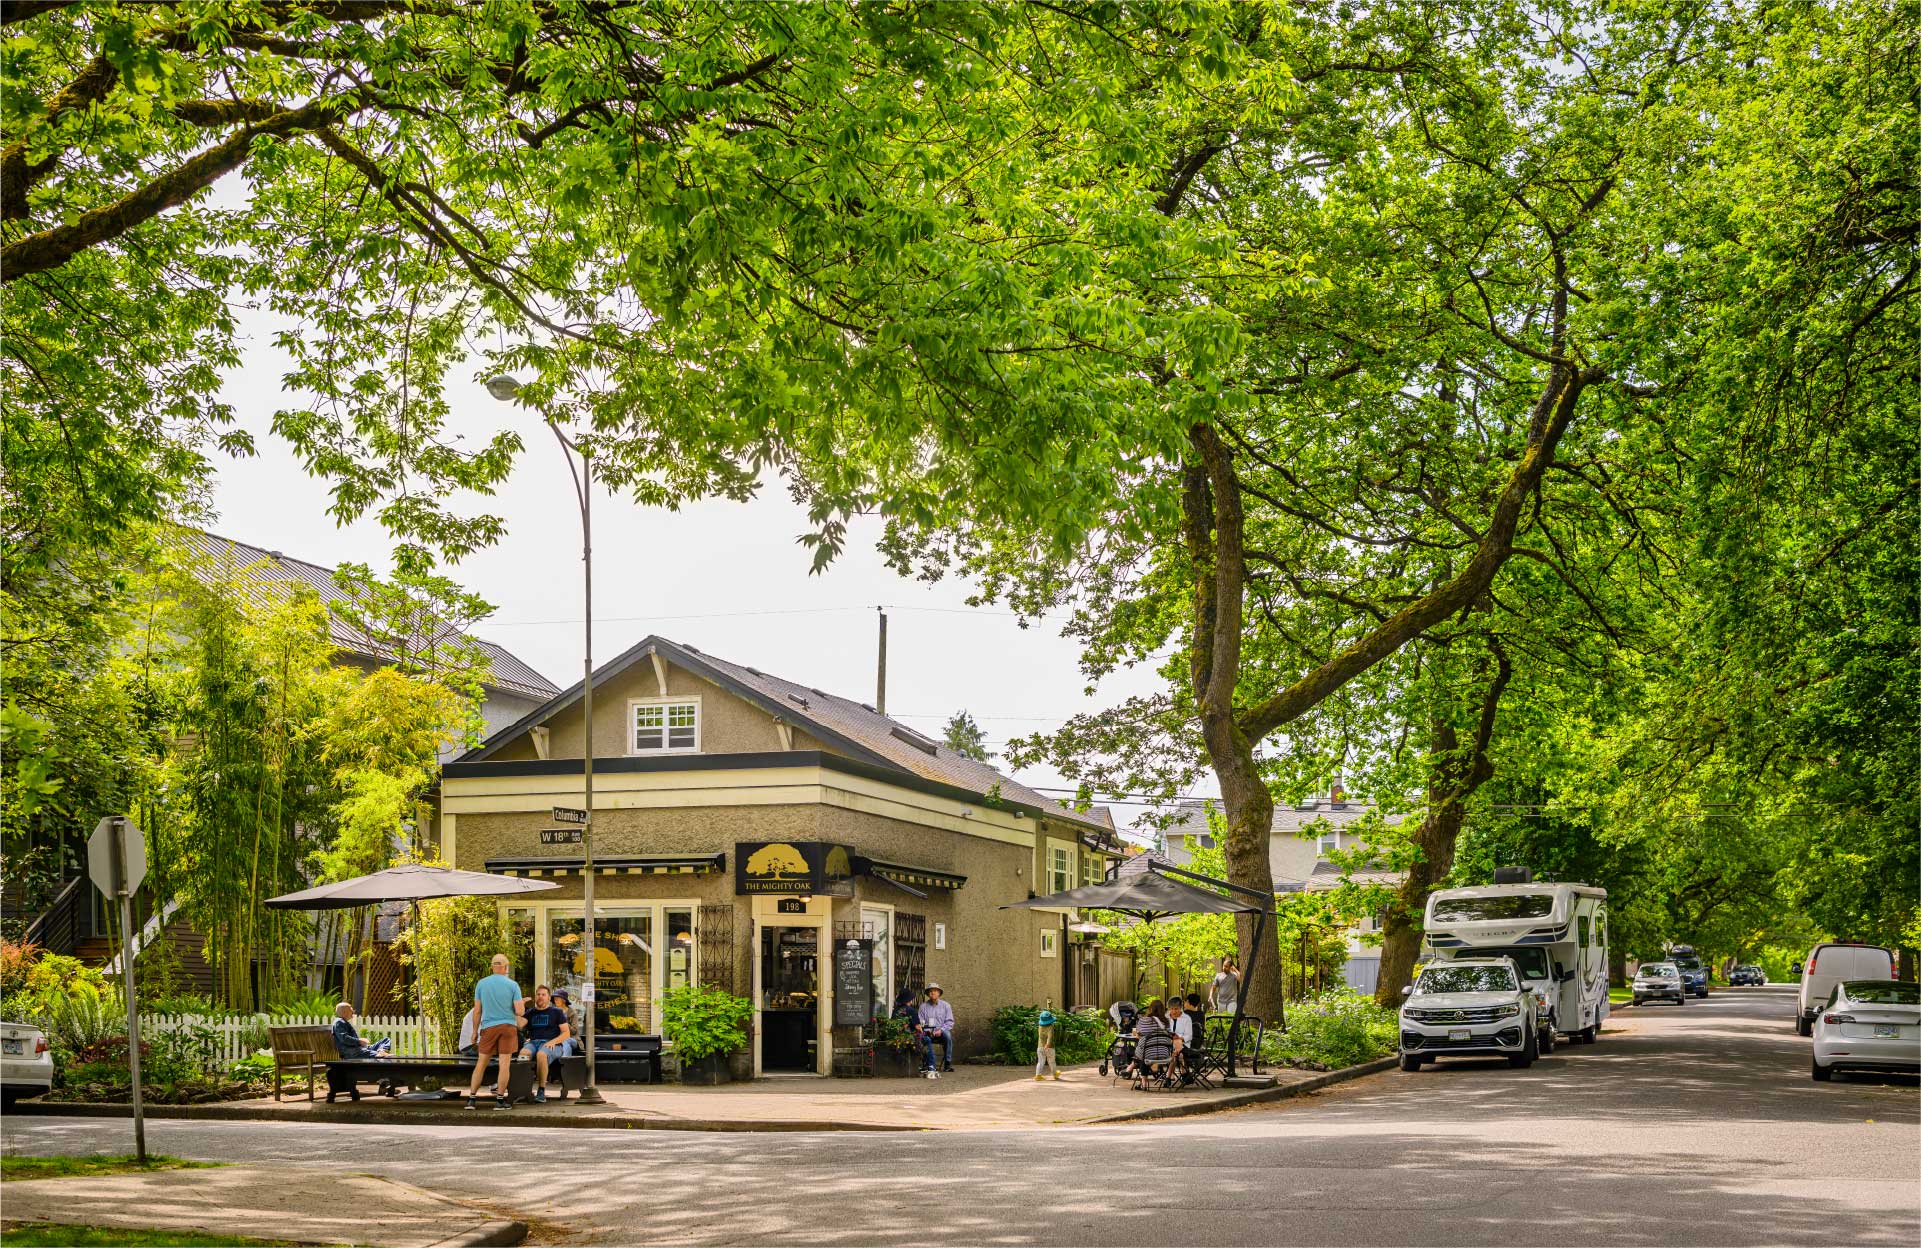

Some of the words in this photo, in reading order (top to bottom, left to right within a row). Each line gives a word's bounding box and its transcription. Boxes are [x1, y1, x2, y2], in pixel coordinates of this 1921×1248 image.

[555, 810, 579, 822] Columbia
[542, 832, 551, 842] W
[554, 831, 570, 842] 18th
[745, 882, 760, 890] THE
[762, 882, 793, 890] MIGHTY
[794, 882, 811, 890] OAK
[785, 902, 800, 911] 198
[841, 961, 867, 970] SPECIALS
[596, 993, 628, 1009] ERIES
